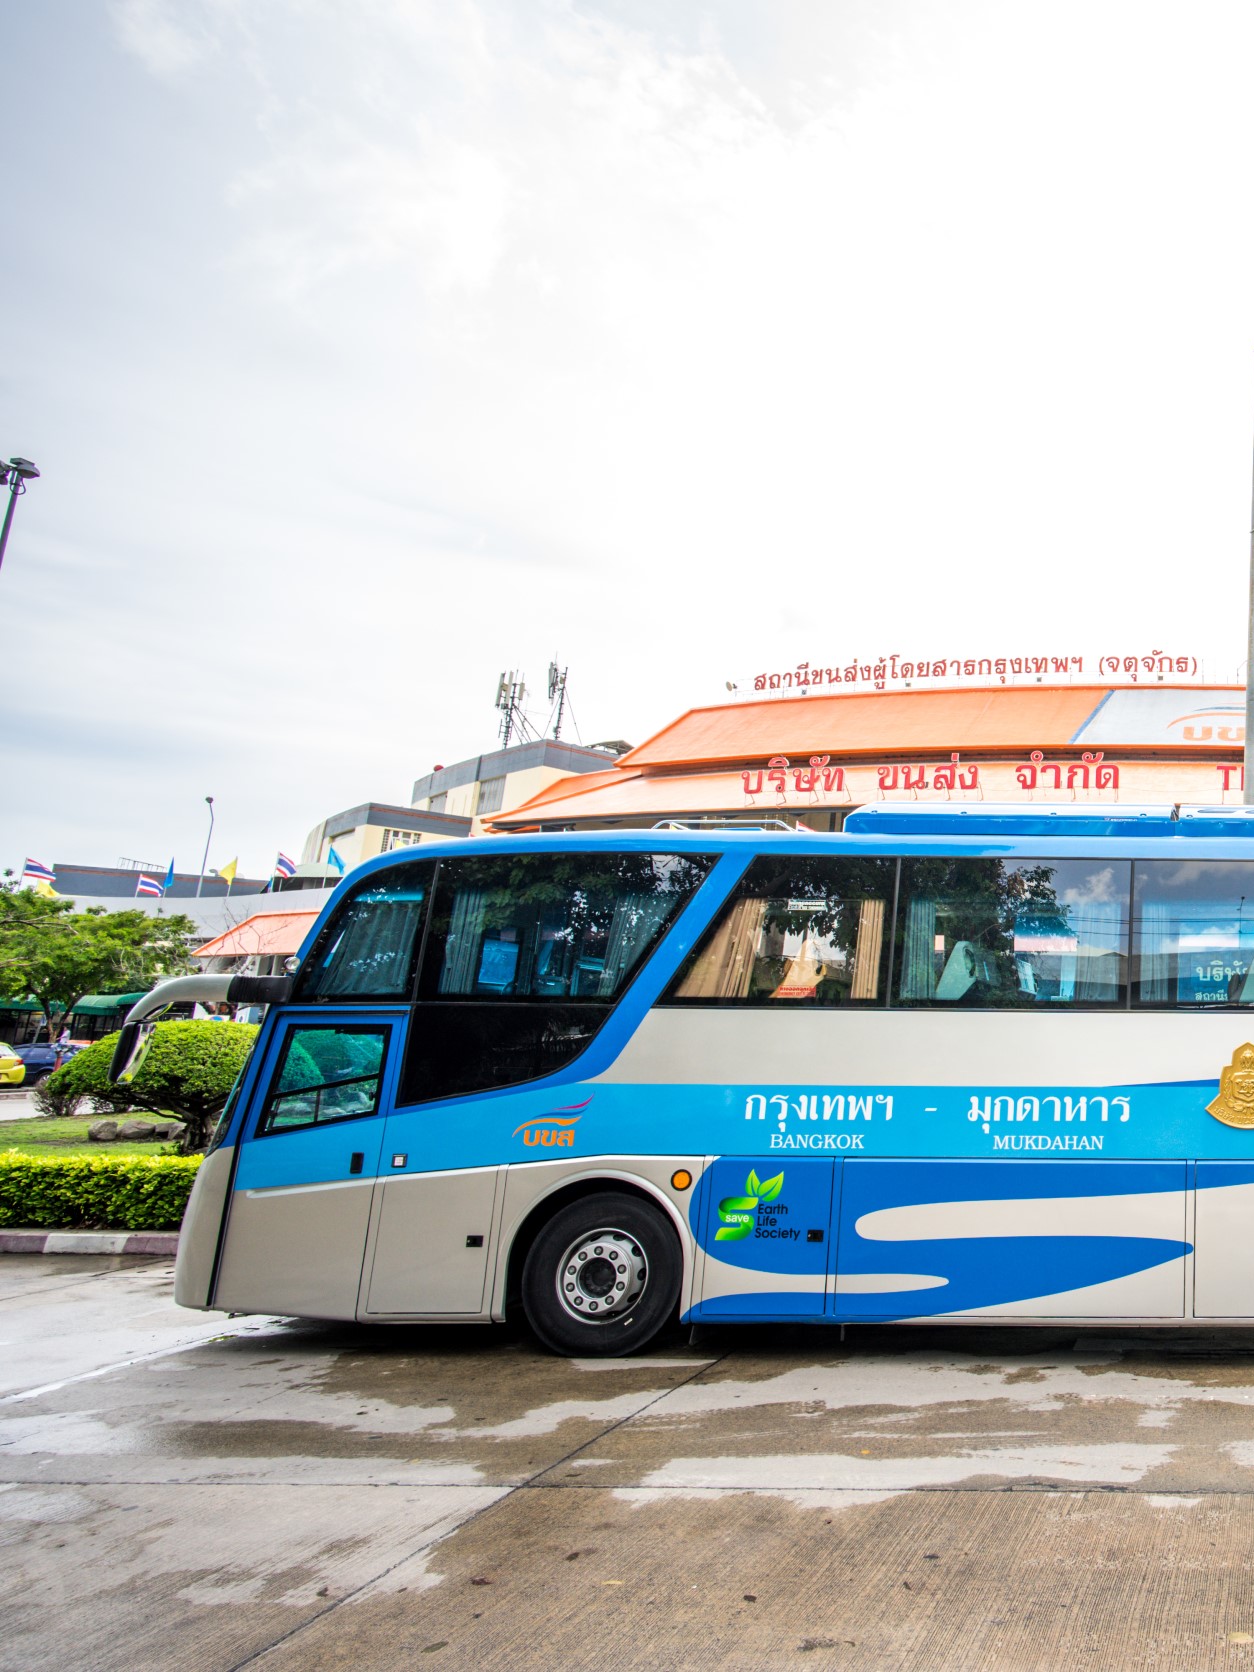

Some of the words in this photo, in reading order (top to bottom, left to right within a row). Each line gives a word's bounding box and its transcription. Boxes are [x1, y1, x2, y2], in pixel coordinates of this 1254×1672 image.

[754, 654, 1083, 690] สถานีขนส่งผู้โดยสารกรุงเทพฯ
[1098, 649, 1199, 682] (จตุจักร)
[741, 754, 846, 794] บริษัท
[877, 752, 979, 792] ขนส่ง
[1015, 750, 1121, 790] จำกัด
[744, 1094, 894, 1133] กรุงเทพฯ
[967, 1093, 1131, 1135] มุกดาหาร
[523, 1129, 576, 1147] บขส
[770, 1133, 865, 1150] BANGKOK
[993, 1135, 1105, 1151] MUKDAHAN
[757, 1203, 789, 1215] Earth
[725, 1214, 750, 1223] save
[756, 1215, 778, 1227] Life
[754, 1227, 801, 1242] Society
